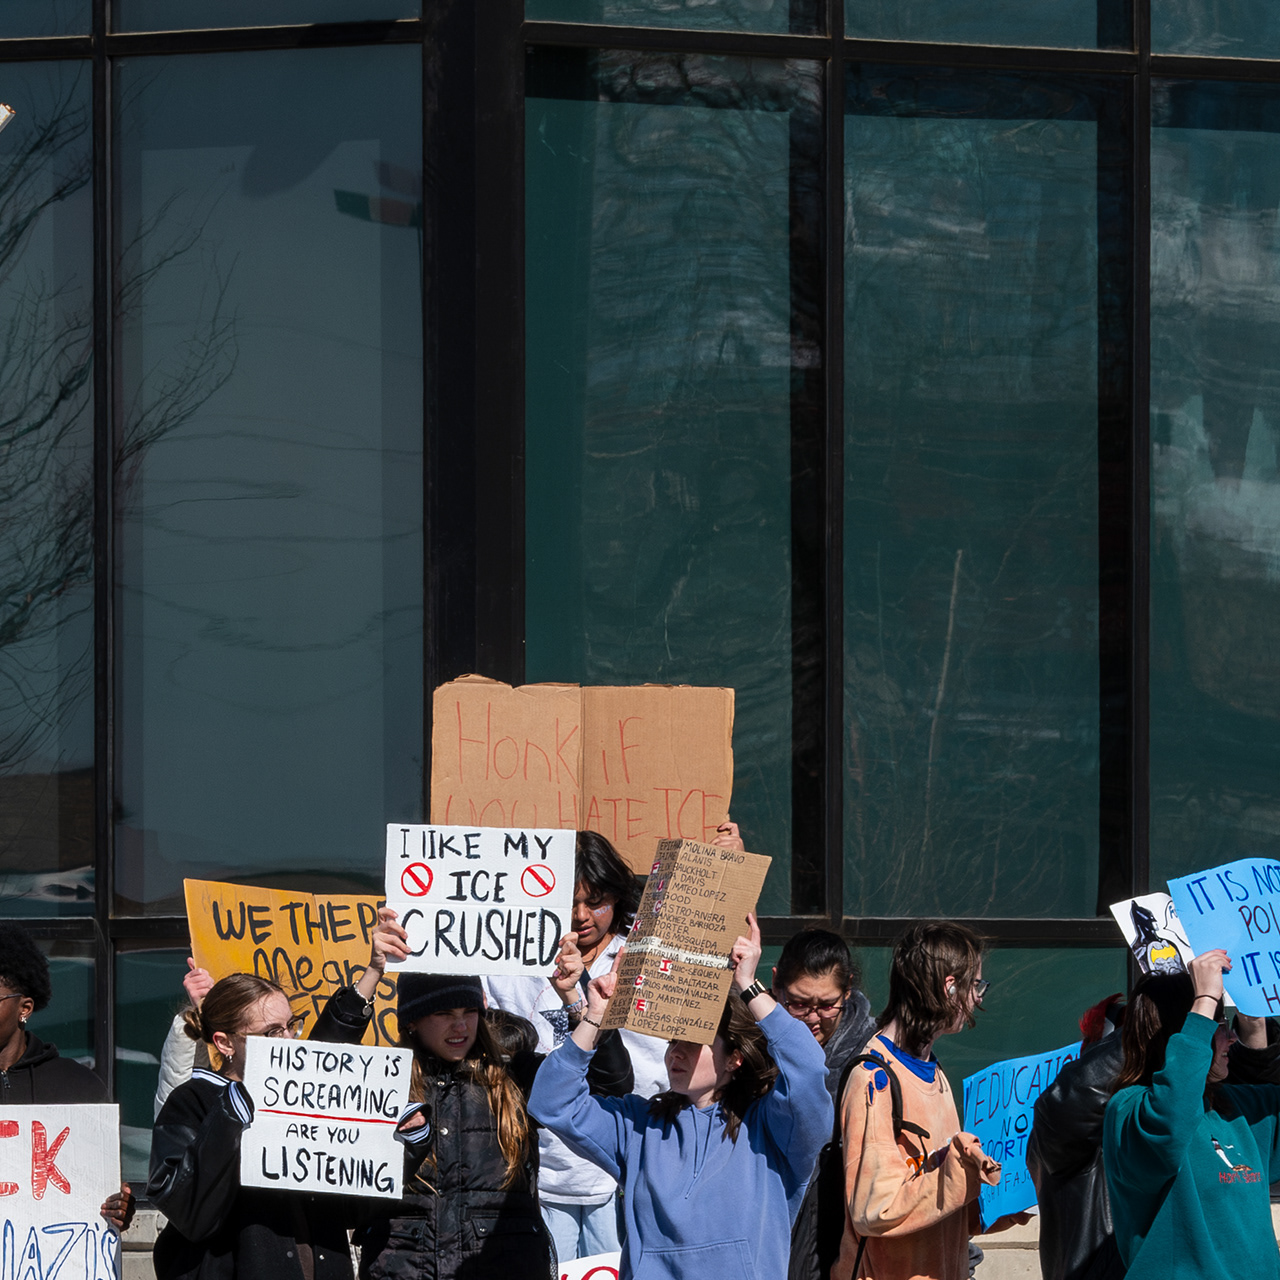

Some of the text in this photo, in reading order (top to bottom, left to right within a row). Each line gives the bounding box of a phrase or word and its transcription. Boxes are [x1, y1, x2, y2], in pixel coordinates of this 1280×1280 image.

[400, 828, 410, 859] I
[504, 831, 553, 860] MY
[684, 842, 716, 856] MOLINA
[720, 850, 745, 864] BRAVO
[681, 852, 712, 867] ALANIS
[445, 870, 509, 902] ICE
[680, 874, 705, 887] DAVIS
[665, 892, 691, 904] GOOD
[672, 882, 697, 895] MATEO
[699, 889, 726, 902] LOPEZ
[1186, 877, 1215, 915] IT
[1216, 870, 1249, 902] IS
[213, 900, 273, 945] WE
[280, 901, 356, 945] THE
[656, 920, 689, 934] PORTER
[400, 906, 562, 967] CRUSHED
[672, 933, 717, 949] MOSQUEDA
[1241, 951, 1263, 986] IT
[678, 977, 719, 990] BALTAZAR
[656, 994, 701, 1009] MARTINEZ
[691, 989, 719, 1002] VALDEZ
[633, 1009, 671, 1023] VILLEGAS
[632, 1018, 658, 1031] LOPEZ
[661, 1024, 686, 1036] LOPEZ
[270, 1045, 374, 1084] HISTORY
[263, 1076, 399, 1119] SCREAMING
[286, 1123, 360, 1144] ARE YOU
[262, 1146, 395, 1194] LISTENING
